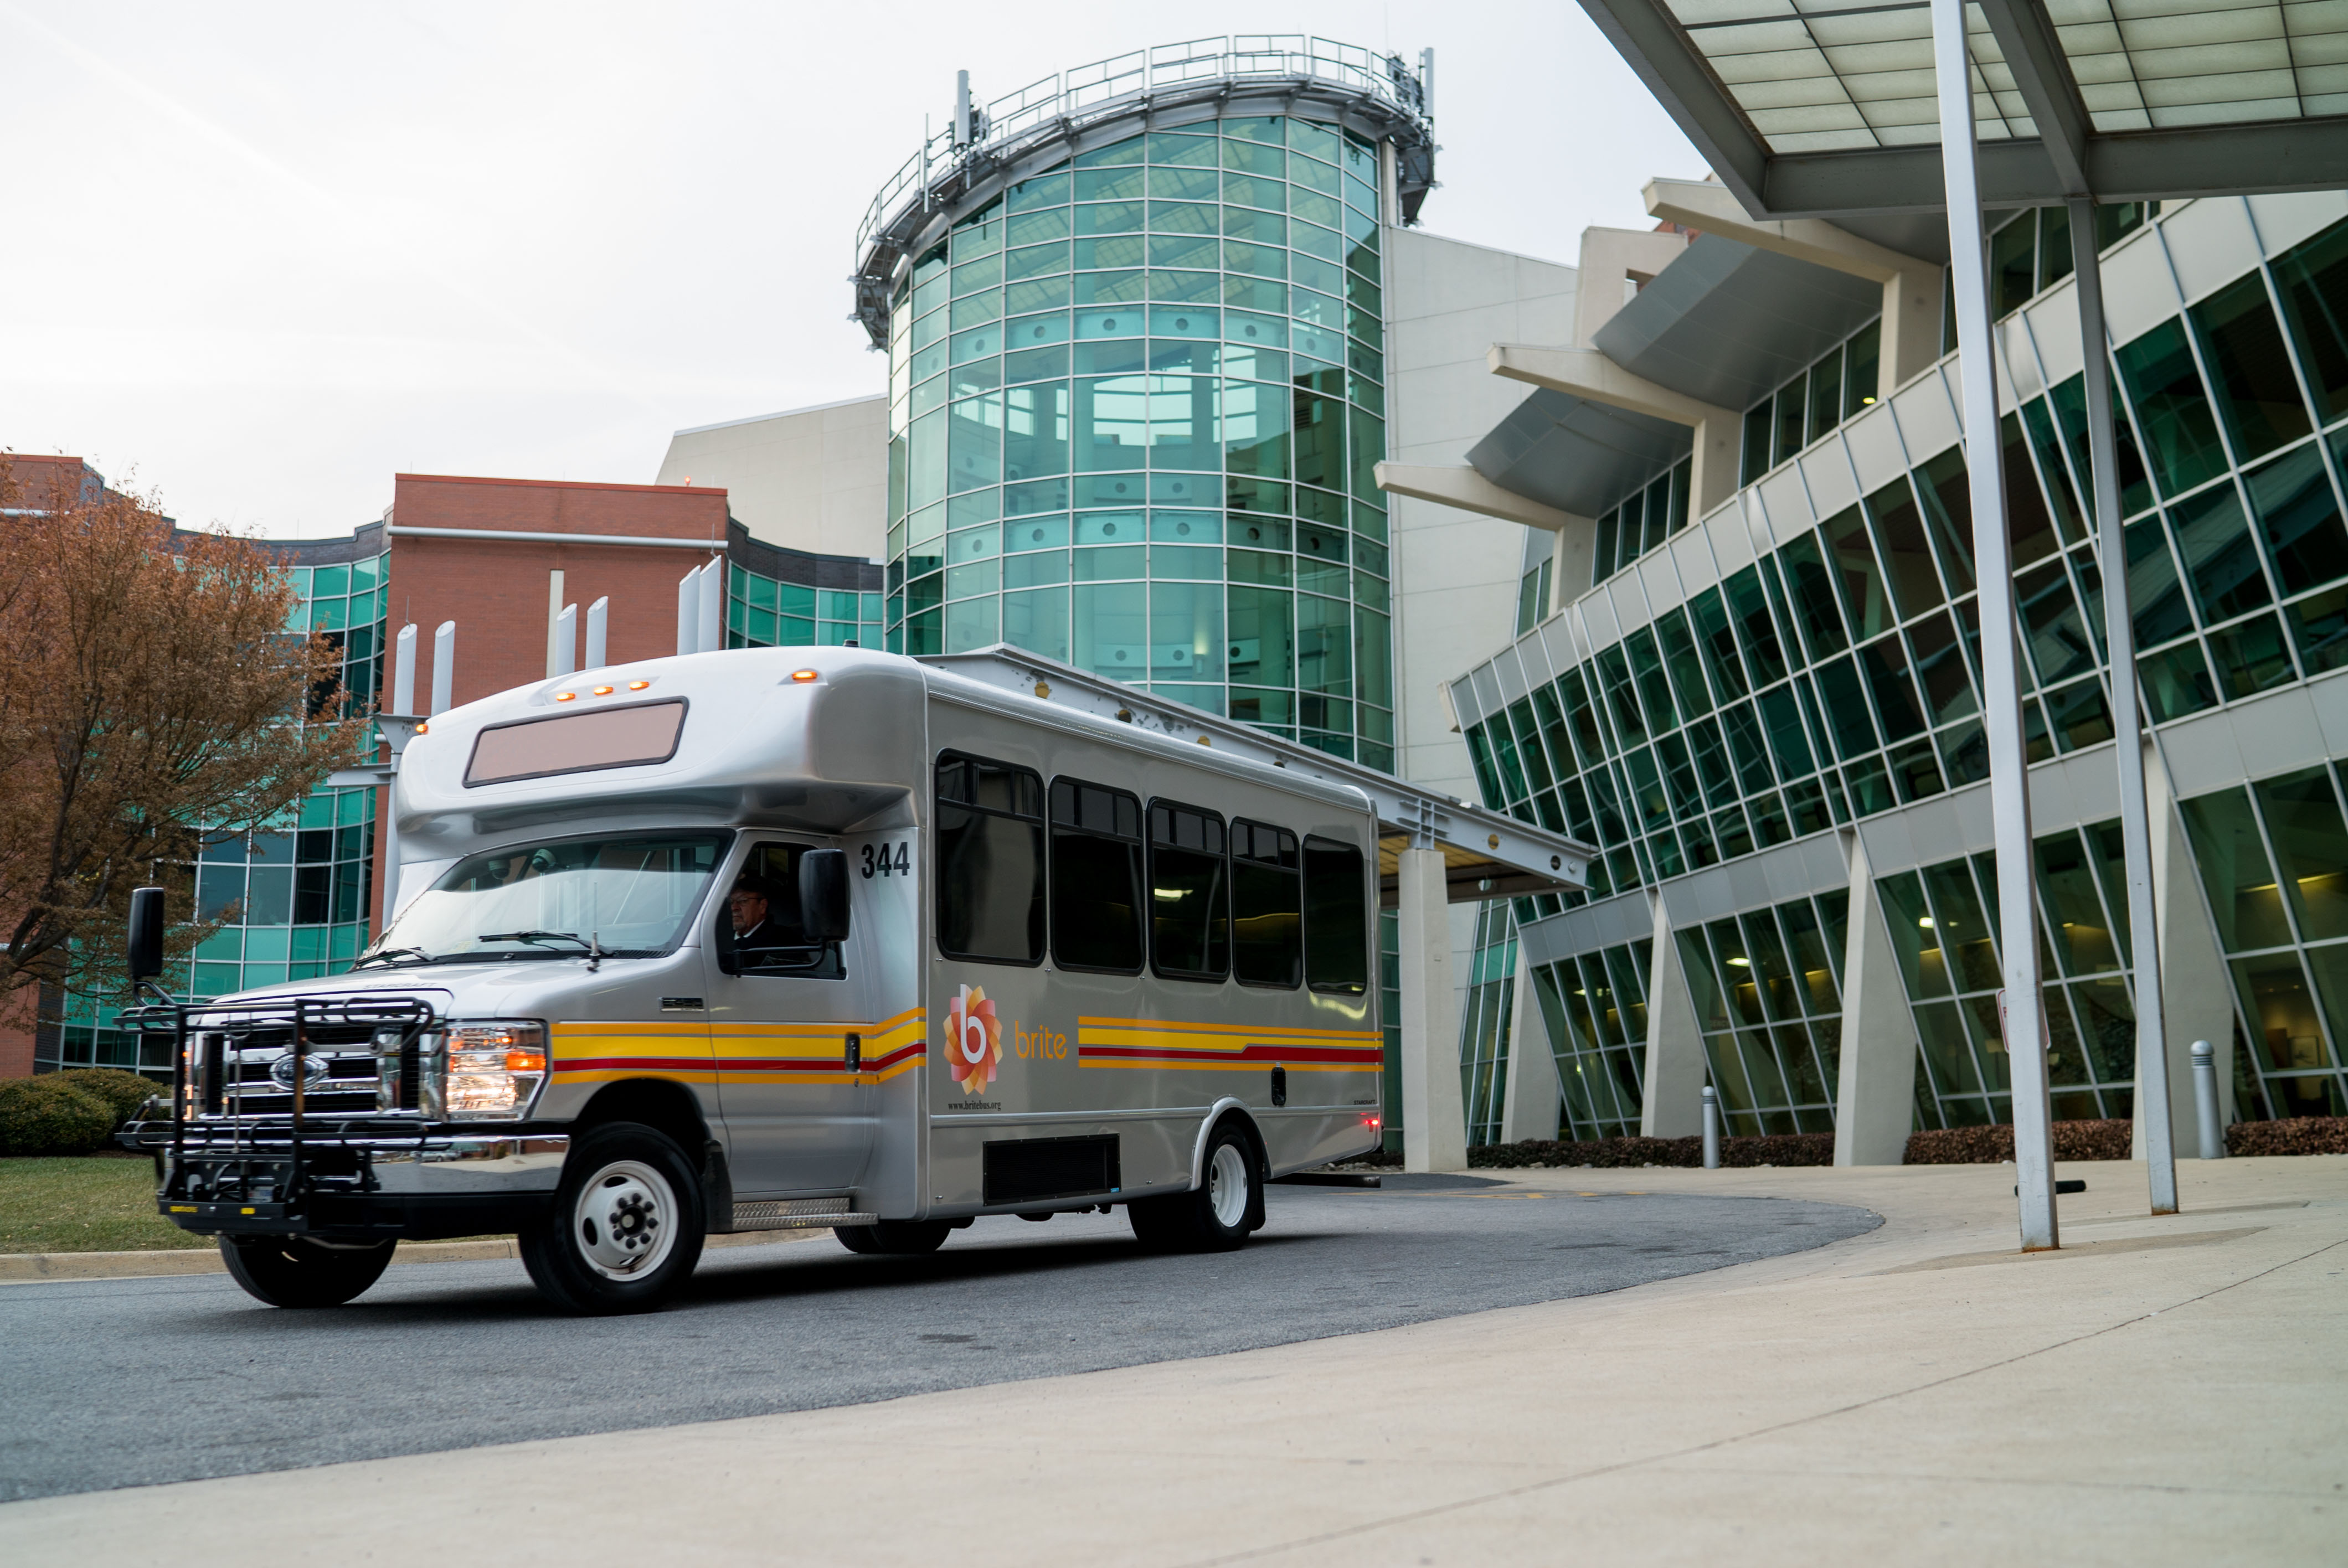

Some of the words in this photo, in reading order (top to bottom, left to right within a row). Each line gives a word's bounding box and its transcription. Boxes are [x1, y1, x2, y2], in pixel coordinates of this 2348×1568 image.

[862, 842, 910, 879] 344
[1015, 1020, 1068, 1060] brite
[948, 1100, 1001, 1112] www.britebus.org
